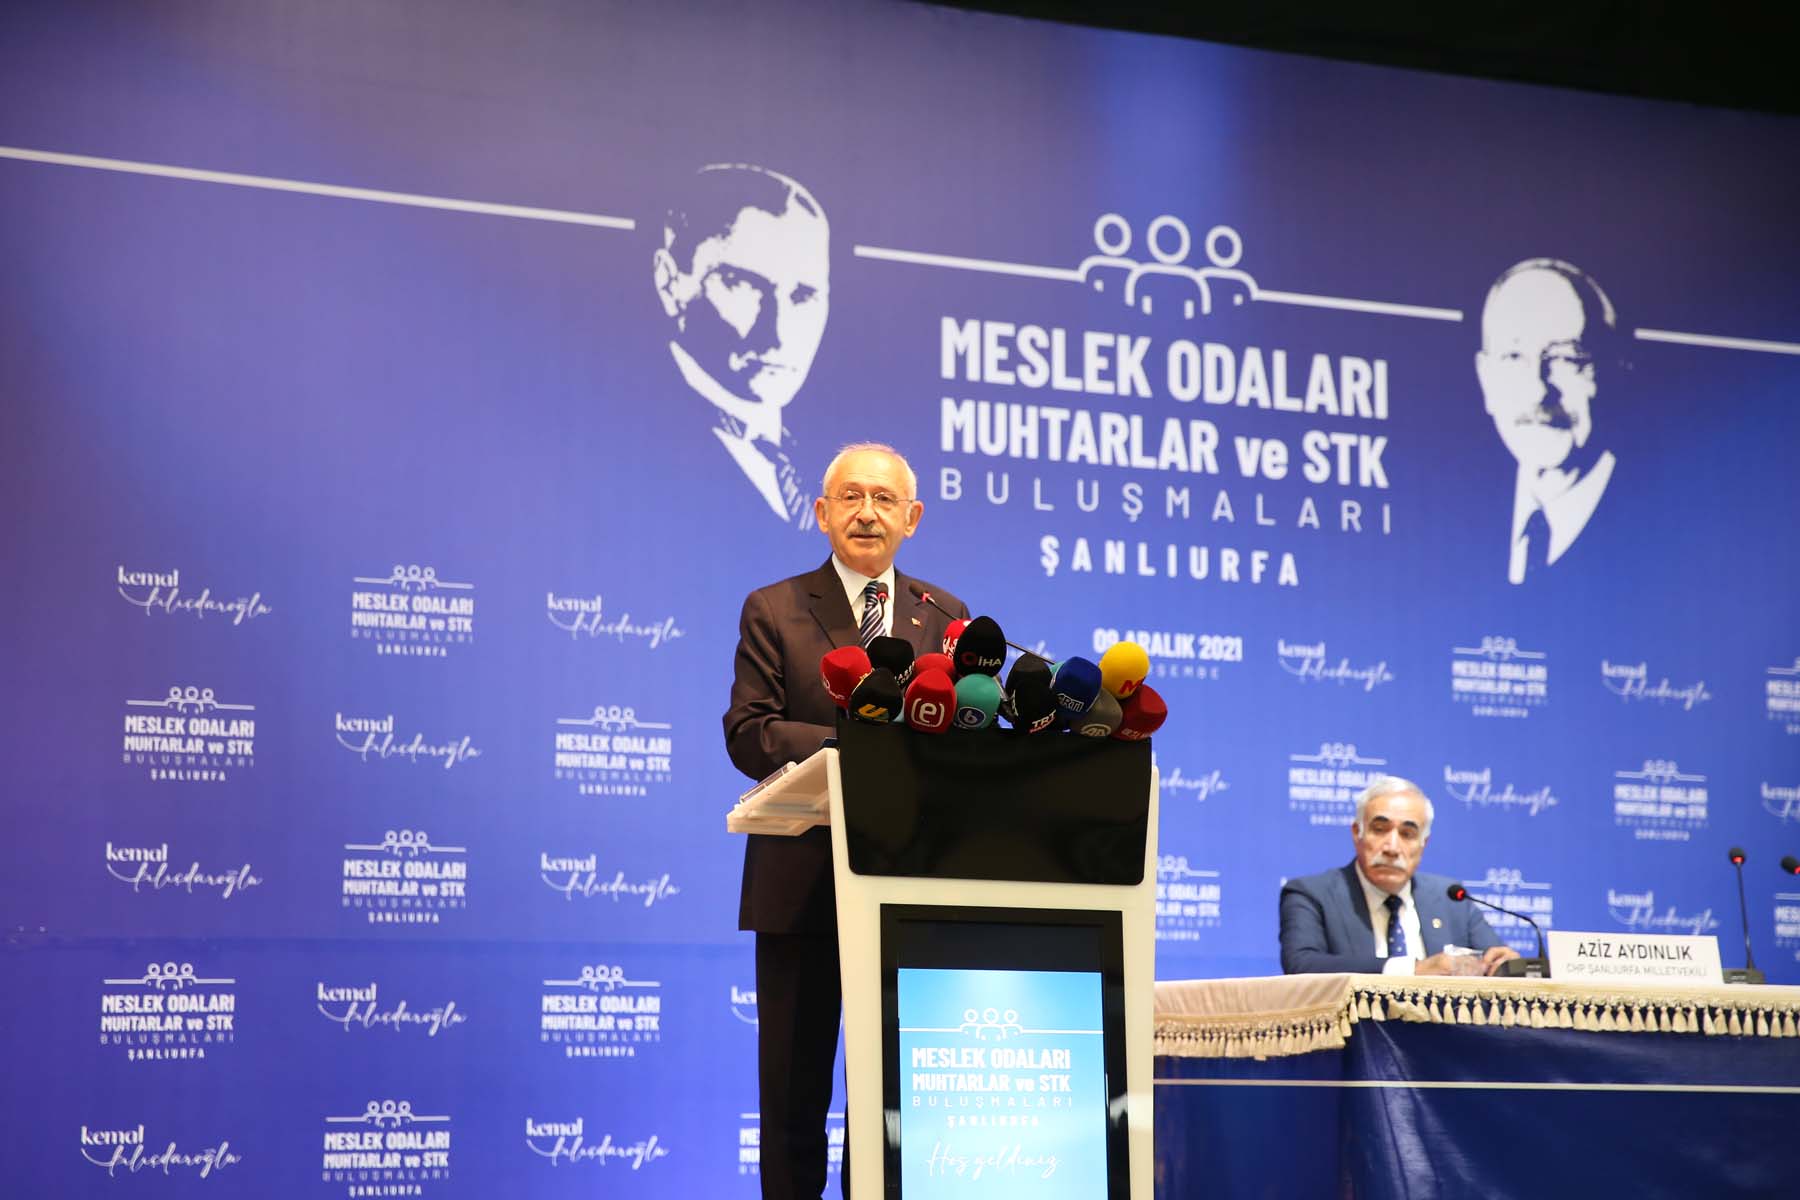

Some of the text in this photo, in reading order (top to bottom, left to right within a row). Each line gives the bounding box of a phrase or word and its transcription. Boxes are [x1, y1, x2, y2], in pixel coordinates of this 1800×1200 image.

[941, 317, 1388, 420] MESLEK ODALARI
[941, 398, 1388, 488] MUHTARLAR ve STK
[941, 467, 1391, 535] BULUŞMALARI
[1040, 535, 1299, 587] ŞANLIURFA
[352, 591, 473, 616] MESLEK ODALARI
[352, 611, 473, 633] MUHTARLAR ve STK
[1198, 634, 1243, 662] 2021
[125, 716, 255, 739] MESLEK ODALARI
[124, 735, 254, 756] MUHTARLAR ve STK
[344, 859, 466, 880] MESLEK ODALARI
[343, 879, 465, 897] MUHTARLAR ve STK
[1577, 938, 1693, 961] AZİZ AYDINLIK
[101, 994, 235, 1014] MESLEK ODALARI
[101, 1015, 233, 1032] MUHTARLAR ve STK
[635, 1015, 659, 1030] STK
[912, 1048, 1071, 1070] MESLEK ODALARI
[912, 1073, 1072, 1093] MUHTARLAR ve STK
[912, 1095, 1072, 1110] BULUŞMALARI
[324, 1131, 449, 1151] MESLEK ODALARI
[324, 1152, 448, 1168] MUHTARLAR ve STK
